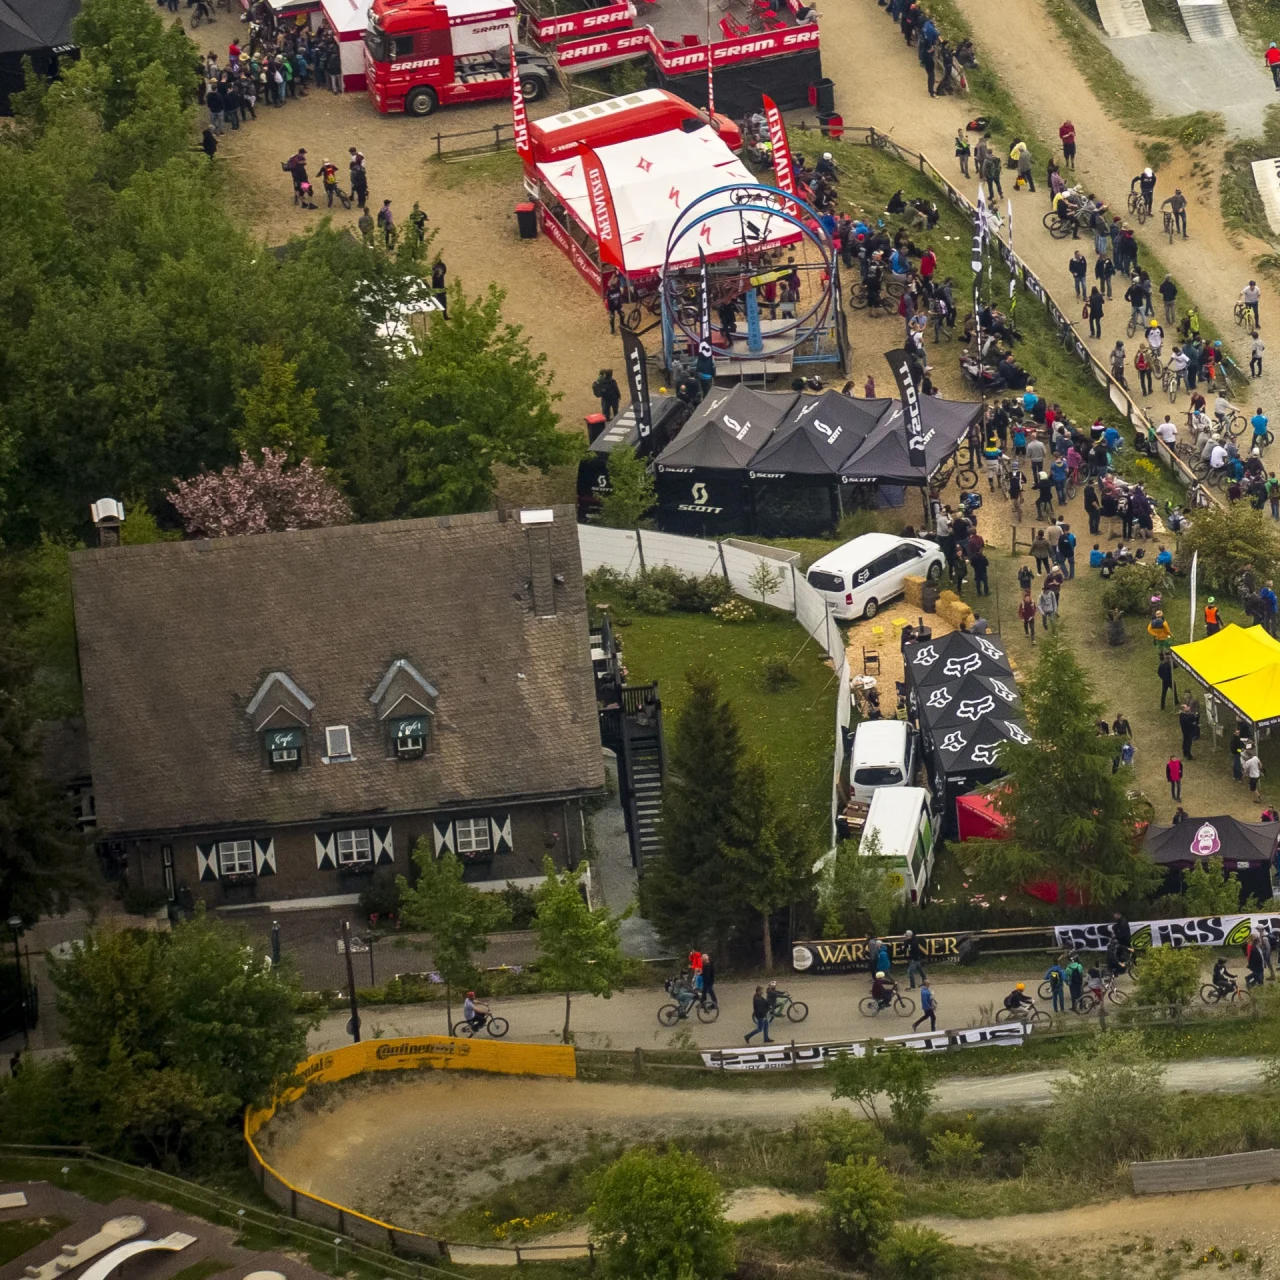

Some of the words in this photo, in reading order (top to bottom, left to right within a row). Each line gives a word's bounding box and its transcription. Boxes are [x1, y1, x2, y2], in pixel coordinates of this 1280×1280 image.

[472, 23, 510, 35] SRAM
[714, 39, 775, 58] SRAM
[783, 31, 819, 46] SRA
[390, 58, 440, 72] SRAM
[735, 421, 752, 441] SCOTT
[827, 426, 843, 445] SCOTT
[677, 504, 723, 515] SCOTT
